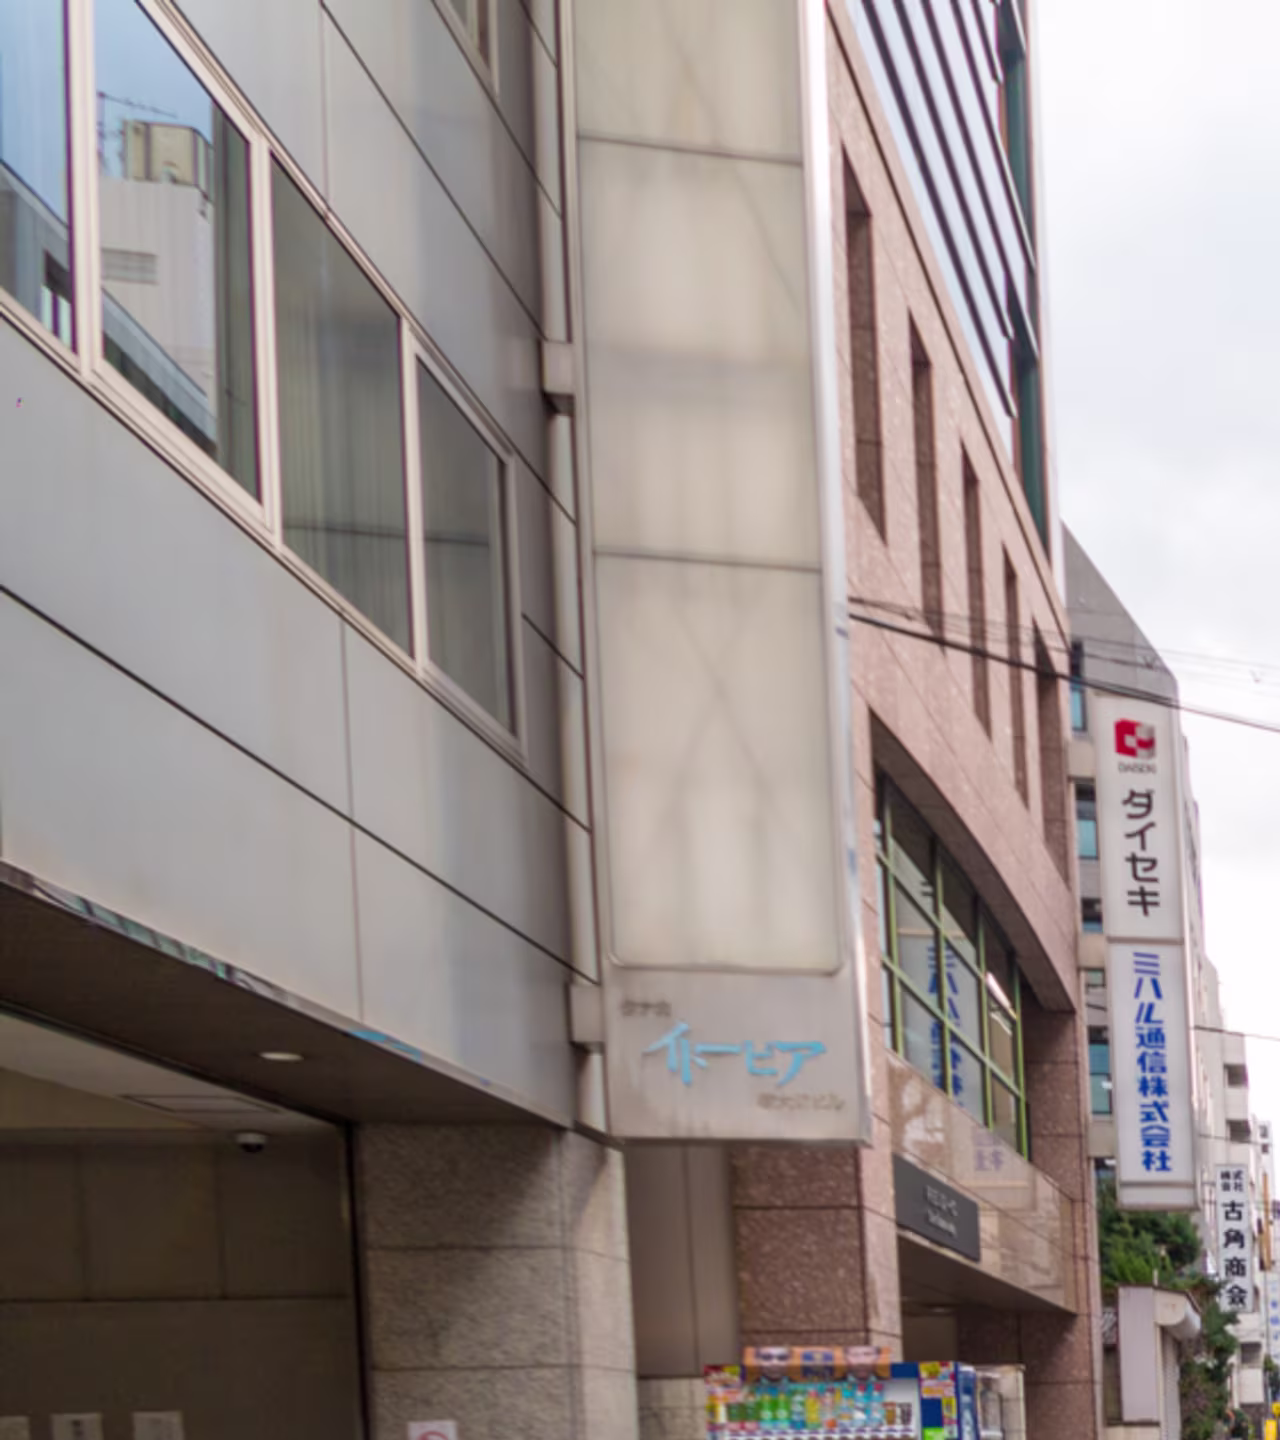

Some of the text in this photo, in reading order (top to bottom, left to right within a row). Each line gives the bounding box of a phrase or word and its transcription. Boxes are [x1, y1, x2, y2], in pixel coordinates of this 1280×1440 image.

[1122, 787, 1160, 917] ダイセキ
[1132, 951, 1173, 1173] ミハル通信株式会社
[1222, 1200, 1247, 1306] 古角商会
